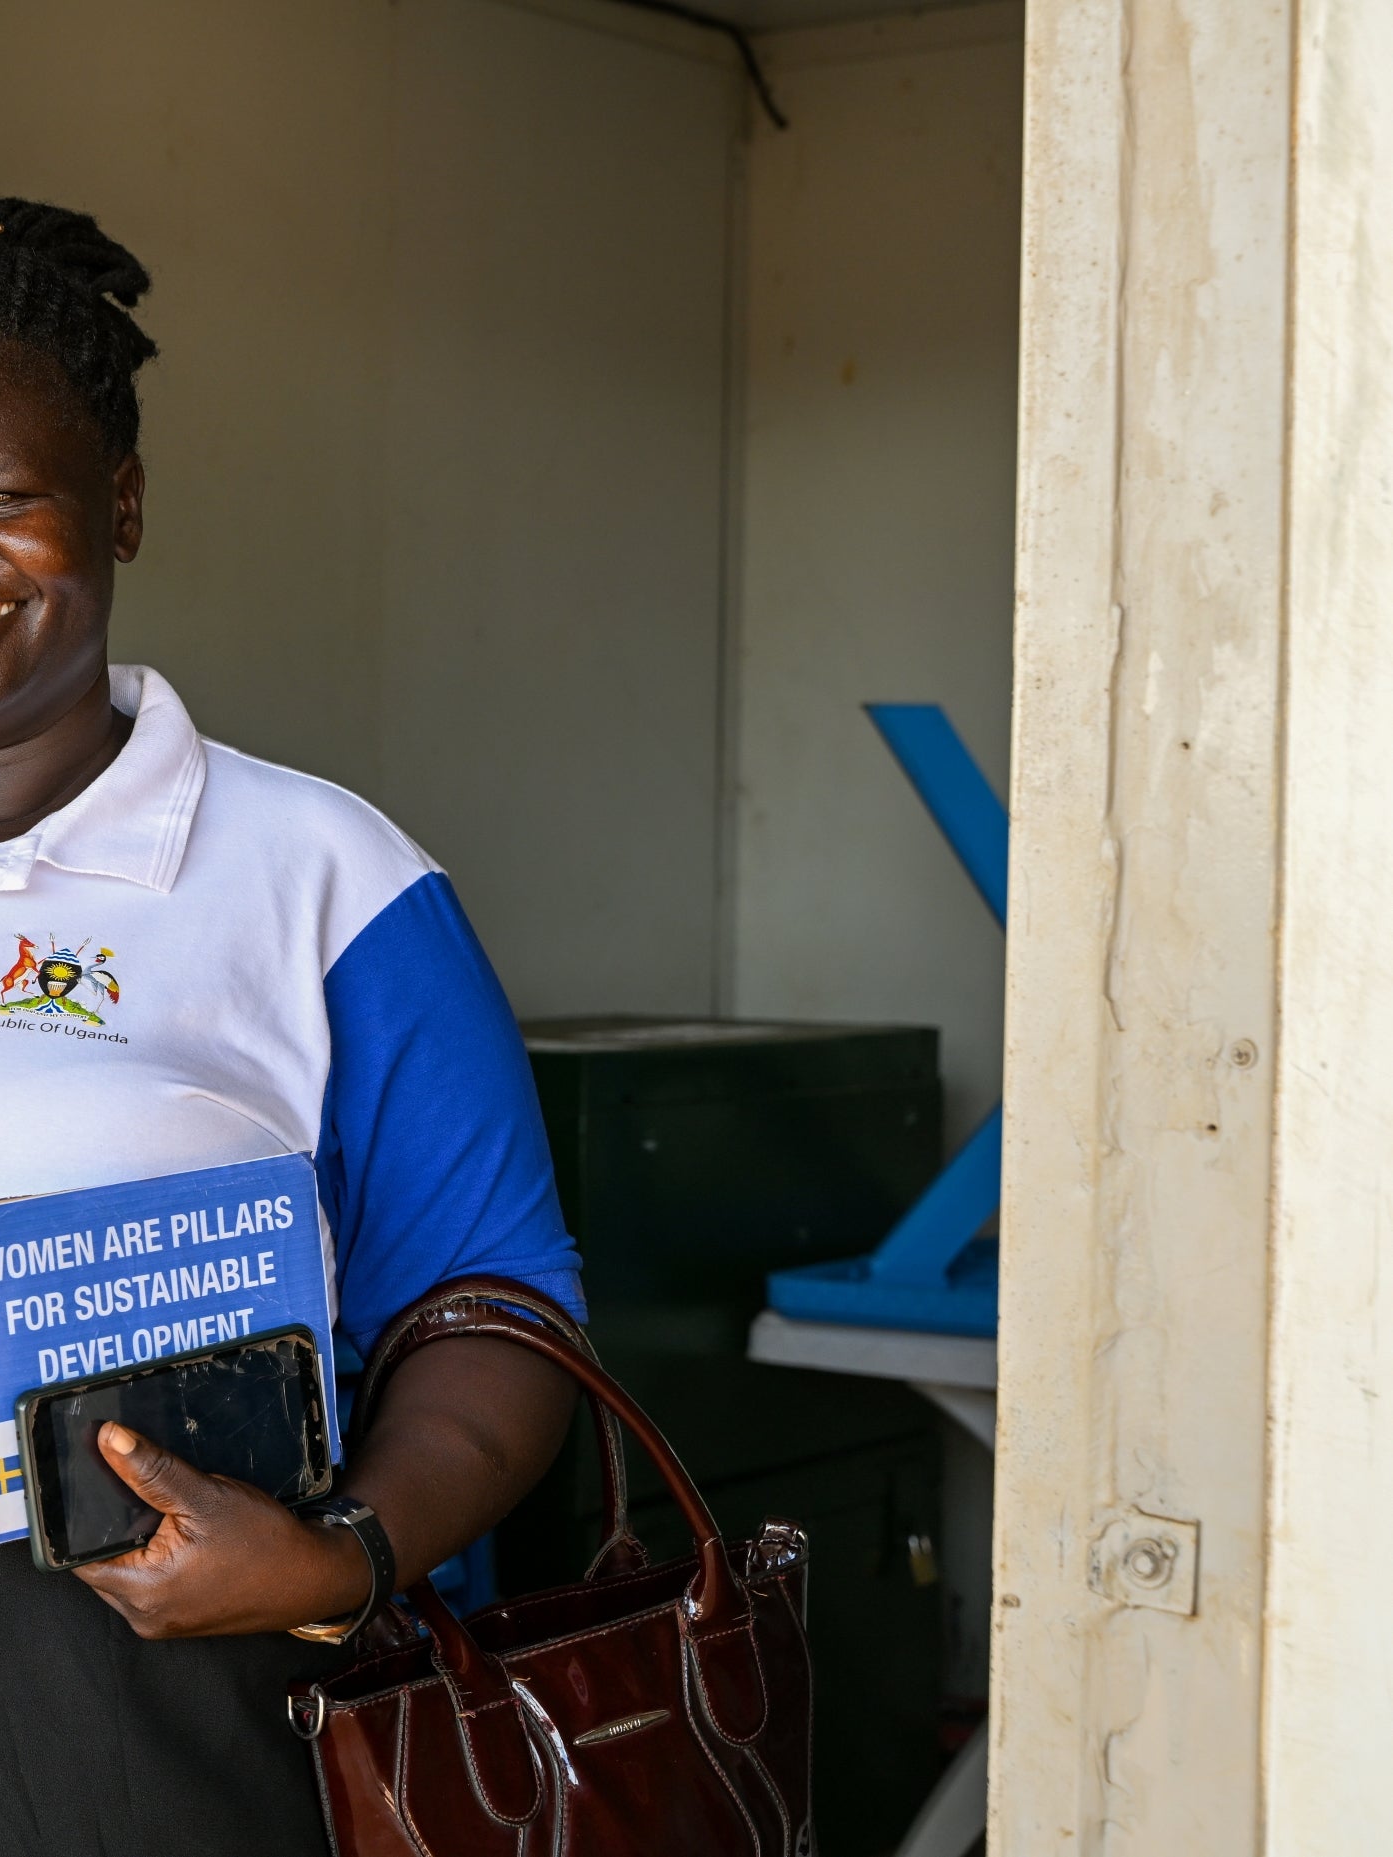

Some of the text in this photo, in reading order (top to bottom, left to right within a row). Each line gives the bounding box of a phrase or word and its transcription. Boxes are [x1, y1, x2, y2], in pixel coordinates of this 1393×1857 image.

[40, 1022, 61, 1033] Of
[65, 1025, 128, 1044] Uganda
[103, 1217, 163, 1261] ARE
[170, 1195, 294, 1248] PILLARS
[5, 1250, 277, 1336] FOR SUSTAINABLE
[38, 1307, 255, 1385] DEVELOPMENT
